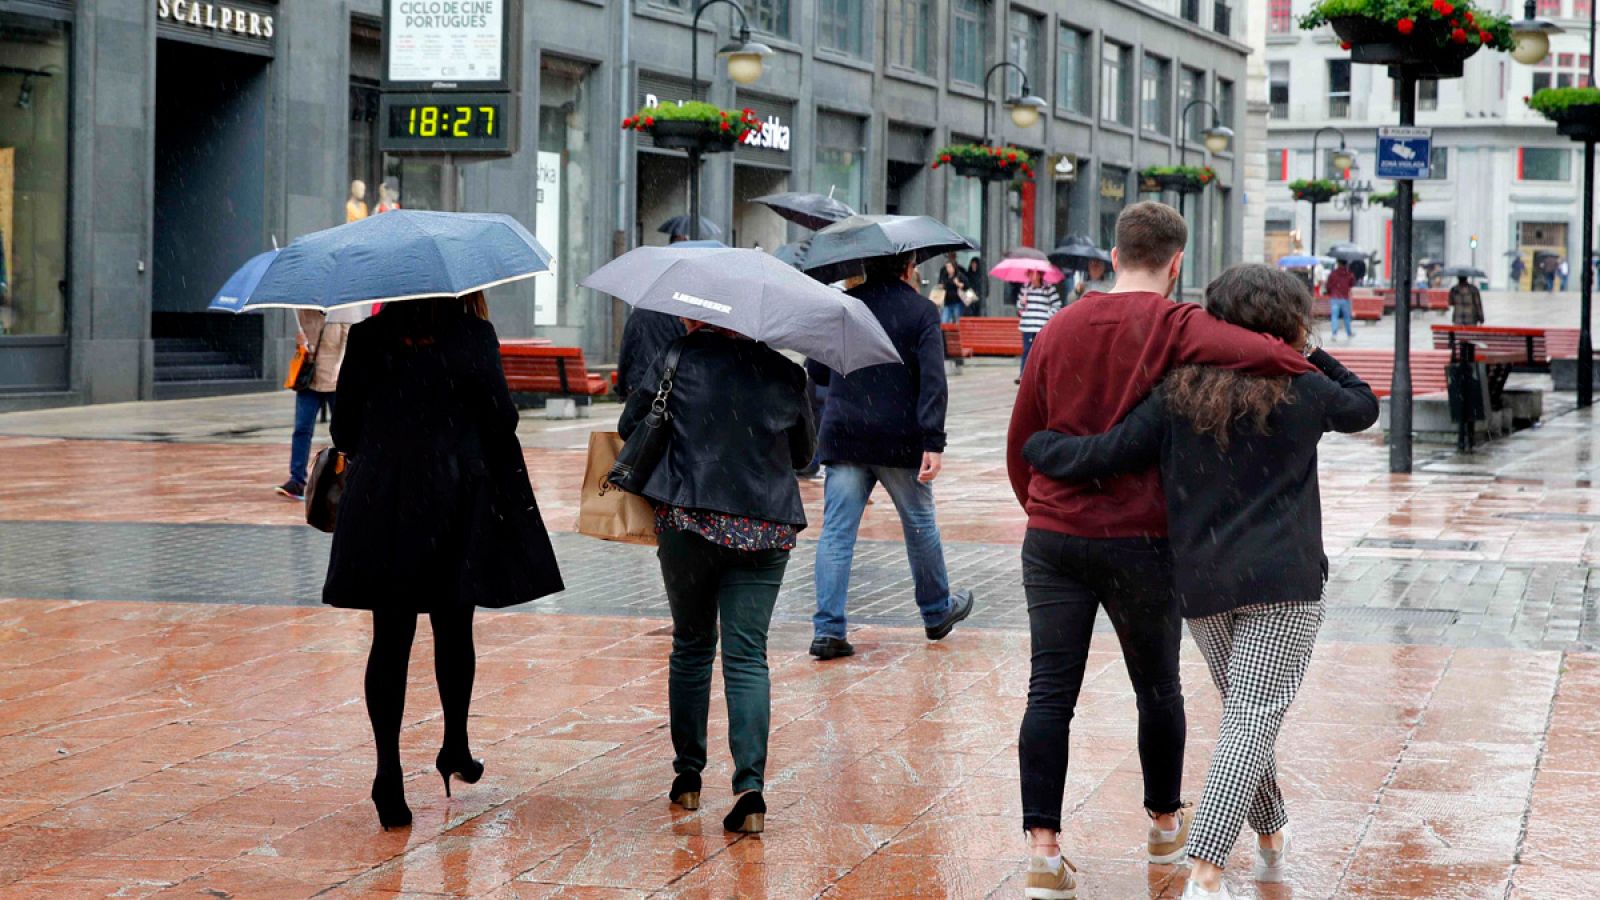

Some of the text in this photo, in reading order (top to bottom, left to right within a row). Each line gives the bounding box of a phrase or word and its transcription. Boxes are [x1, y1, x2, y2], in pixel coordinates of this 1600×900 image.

[159, 0, 273, 37] SCALPERS
[400, 0, 493, 15] CICLO DE CINE
[408, 106, 494, 137] 18:27
